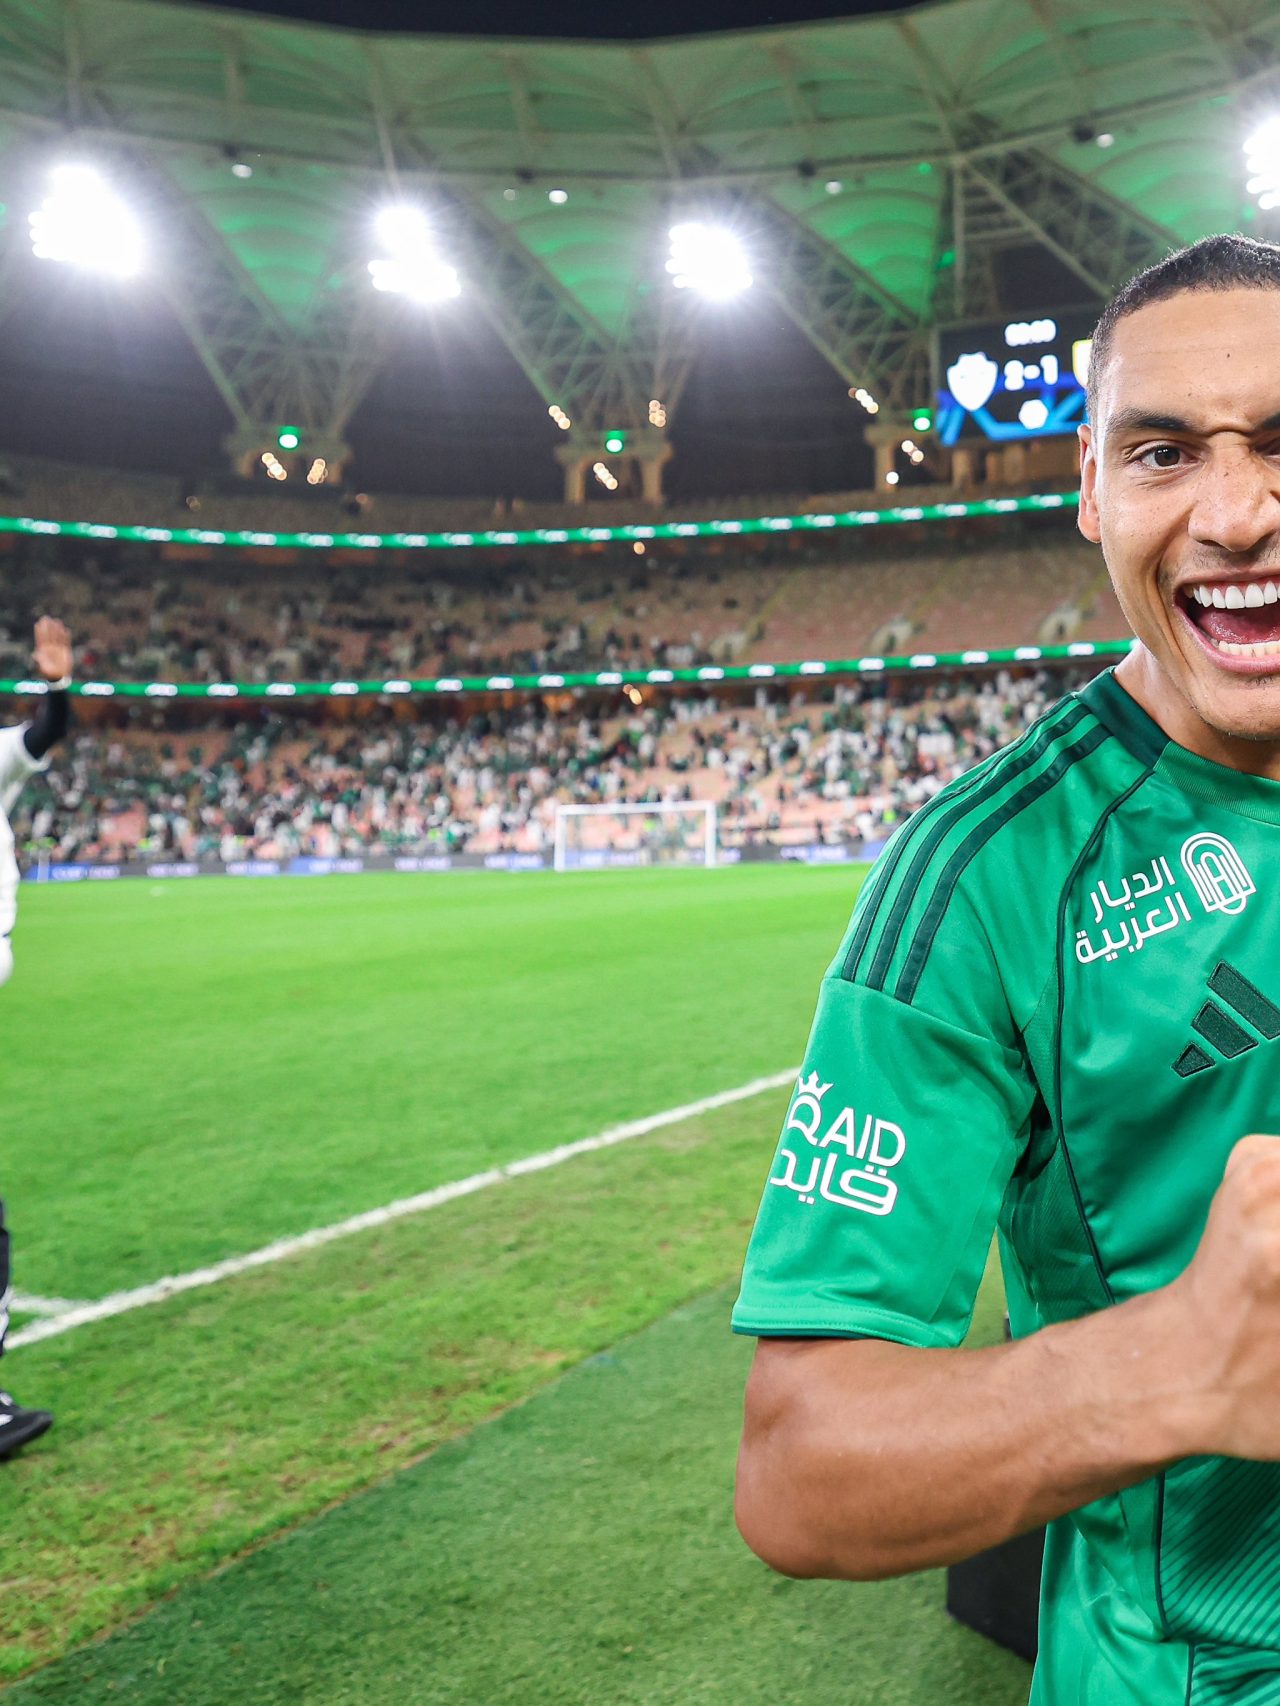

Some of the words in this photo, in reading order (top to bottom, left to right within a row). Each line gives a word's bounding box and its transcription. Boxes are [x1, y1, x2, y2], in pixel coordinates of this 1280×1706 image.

[1090, 856, 1176, 924] الديار
[1075, 891, 1192, 964] العربية
[787, 1095, 906, 1167] QAID
[769, 1148, 899, 1216] قايد
